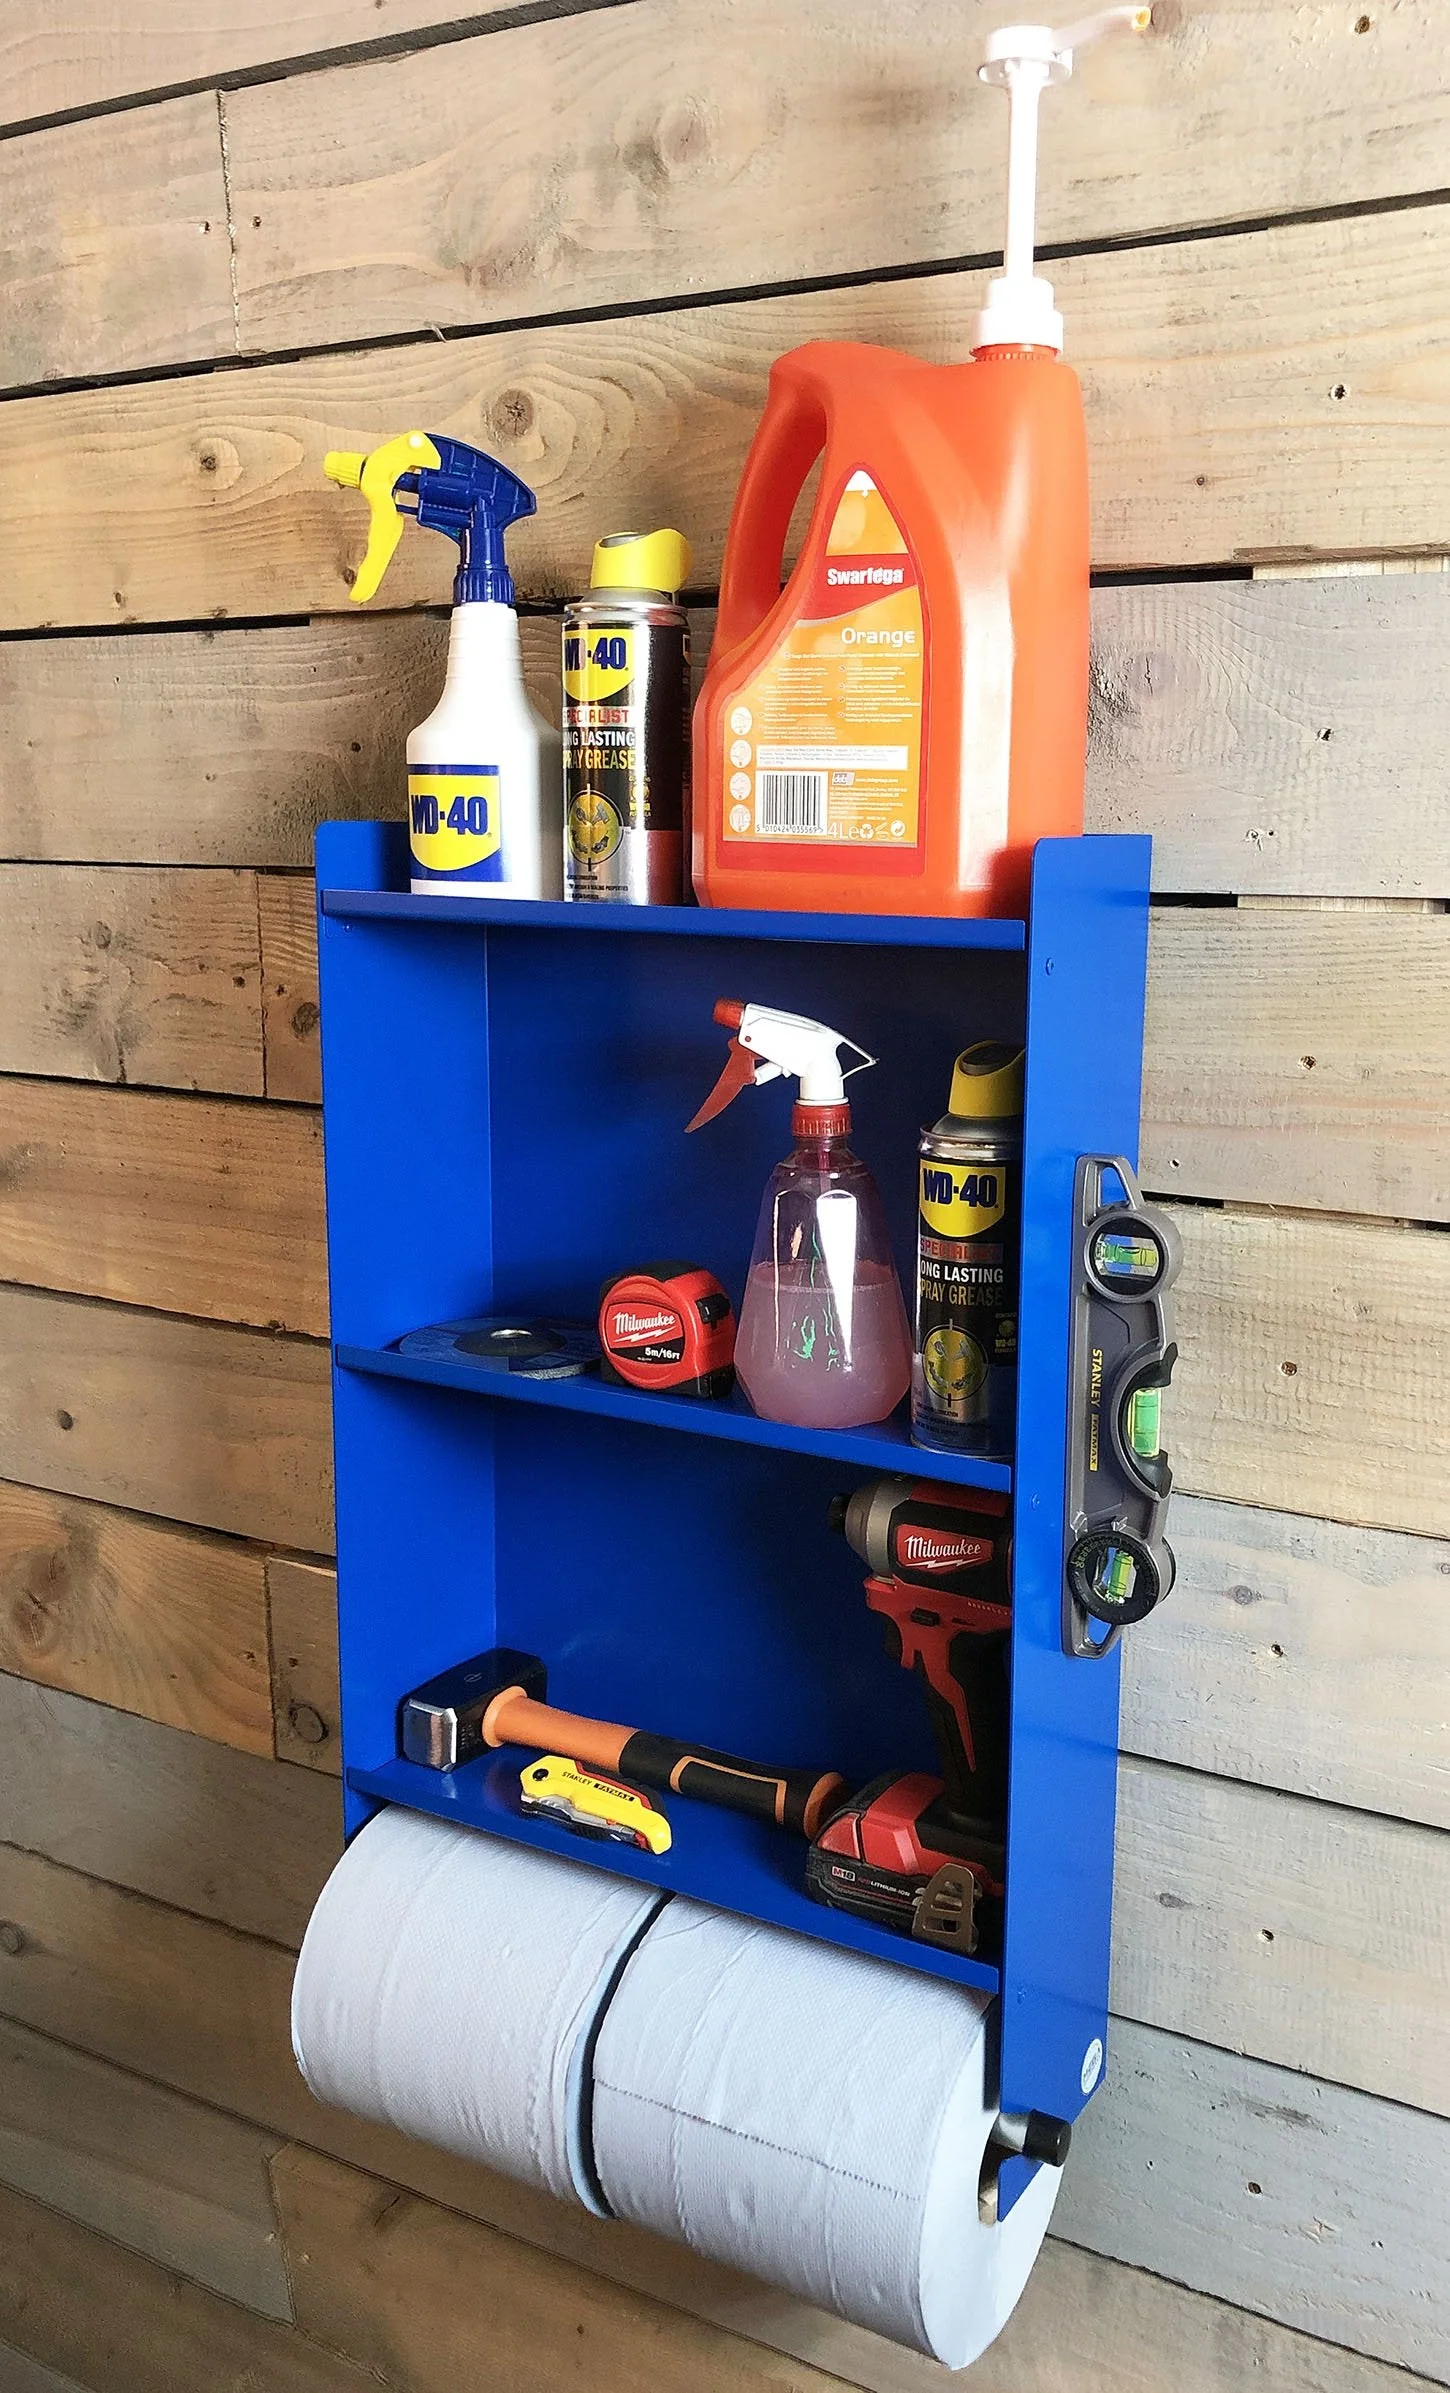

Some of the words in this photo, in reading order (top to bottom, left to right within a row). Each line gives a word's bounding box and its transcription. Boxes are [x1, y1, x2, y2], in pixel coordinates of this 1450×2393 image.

[826, 567, 904, 585] Swarfega
[841, 627, 916, 648] Orange
[581, 731, 636, 747] LASTING
[586, 749, 636, 770] GREASE
[411, 795, 488, 835] WD-40
[923, 1168, 997, 1208] WD-40
[920, 1260, 940, 1279] ONG
[944, 1266, 1004, 1283] LASTING
[948, 1285, 1004, 1307] GREASE
[612, 1312, 675, 1334] Milwaukee
[1091, 1348, 1103, 1408] STANLEY
[904, 1535, 981, 1559] Milwaukee
[832, 1866, 854, 1880] M18
